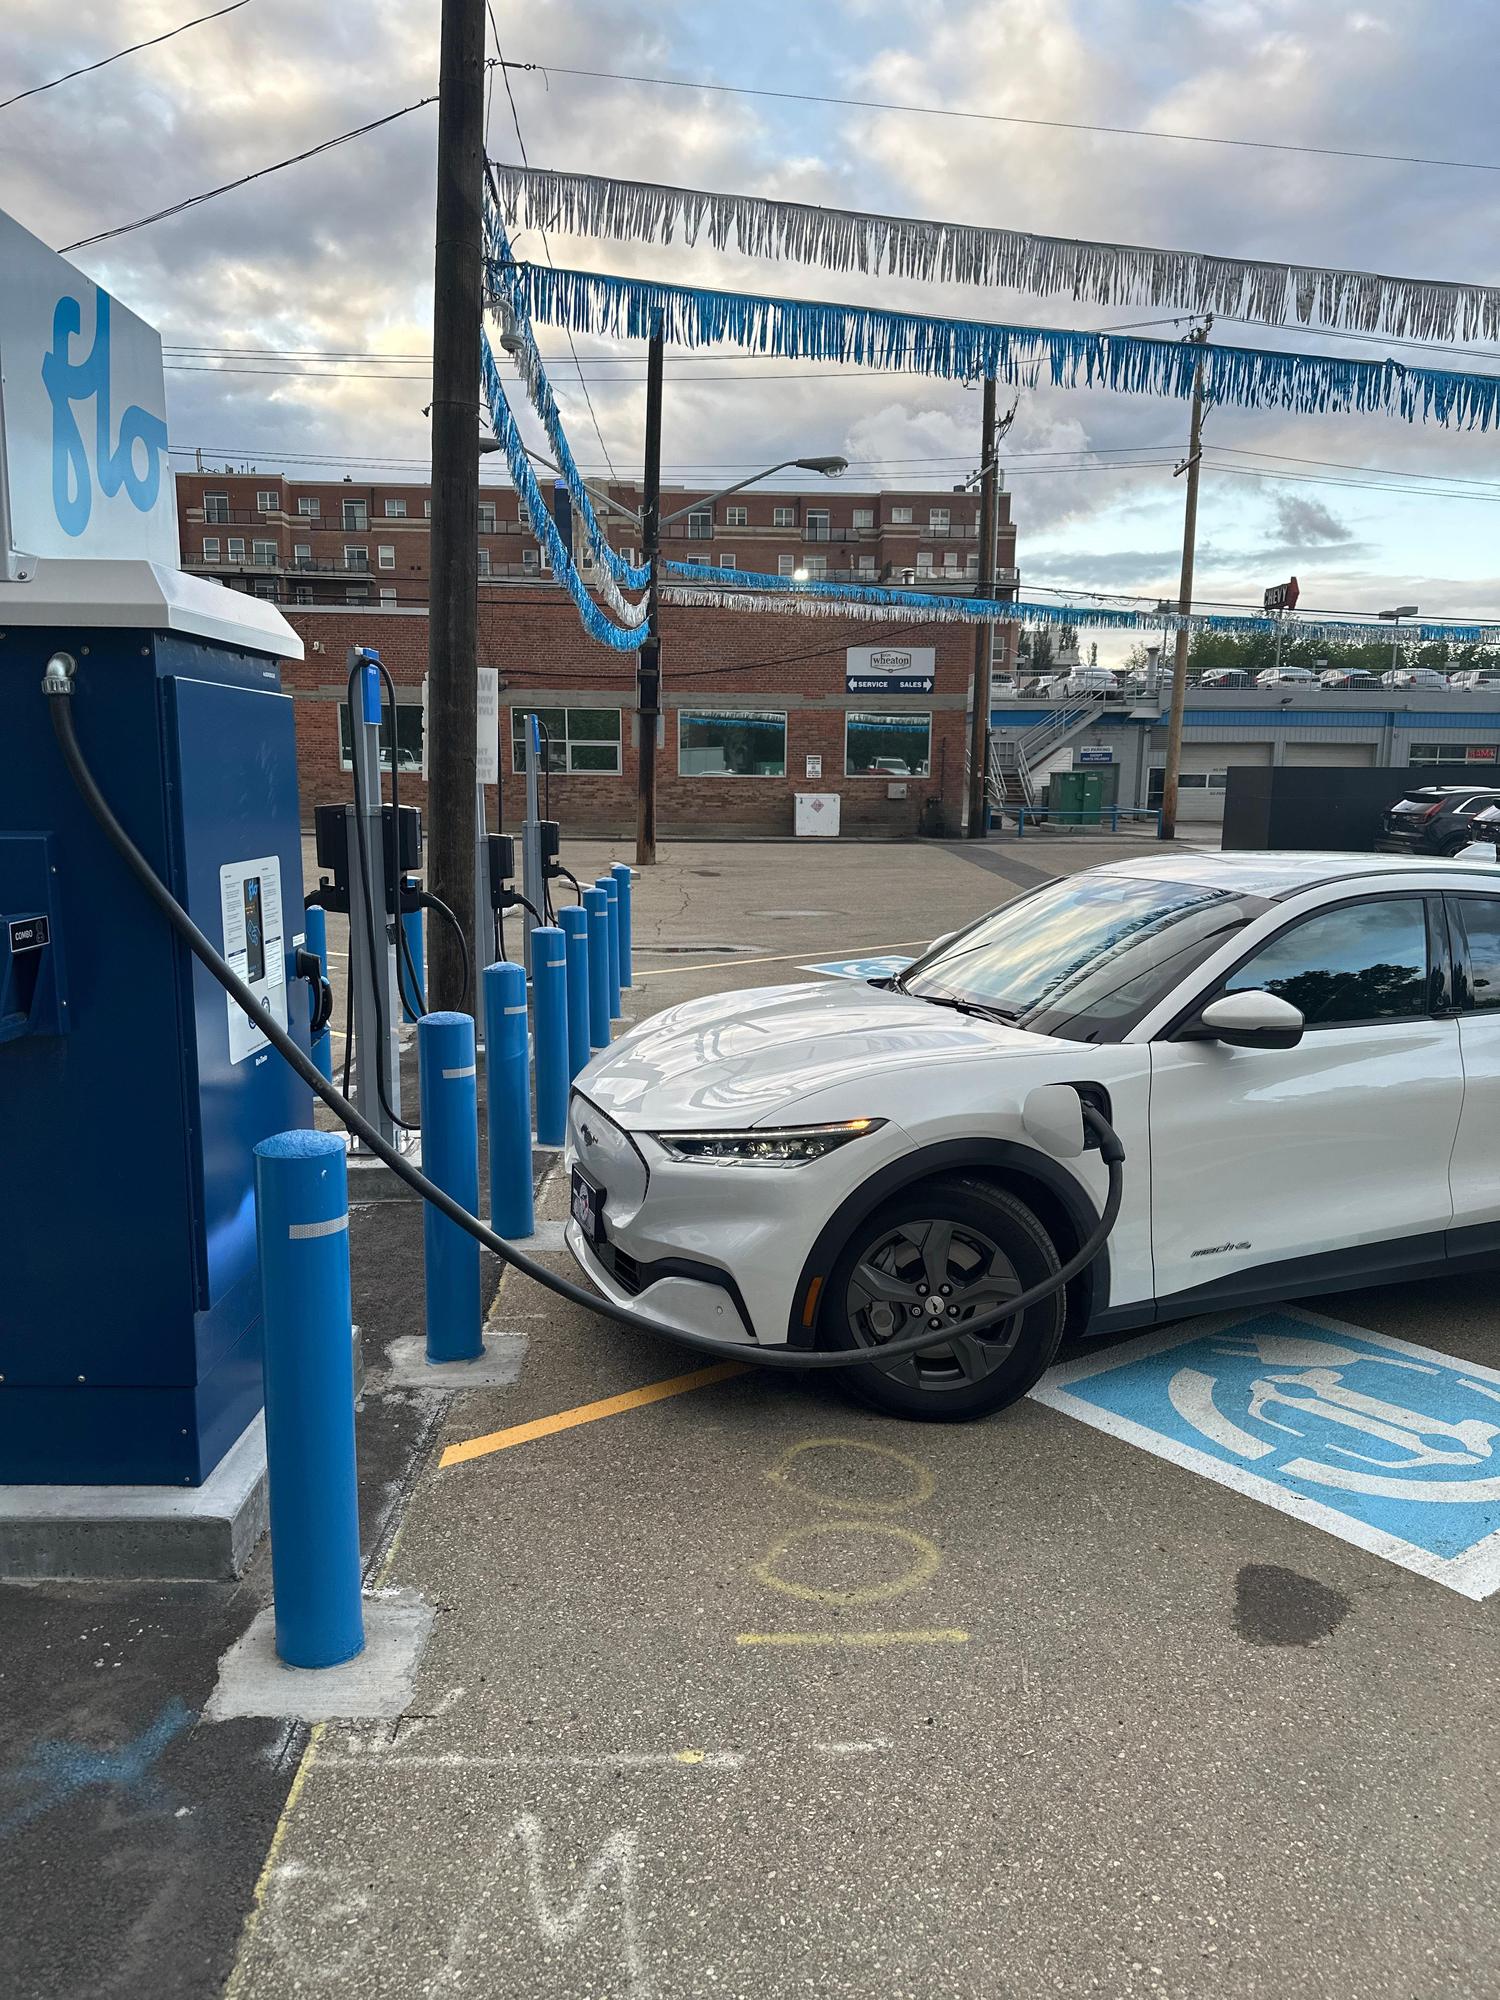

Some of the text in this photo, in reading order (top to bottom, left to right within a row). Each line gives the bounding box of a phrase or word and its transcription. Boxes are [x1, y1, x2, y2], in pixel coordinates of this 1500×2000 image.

[41, 285, 169, 538] flo
[1264, 585, 1288, 606] CHEVY
[873, 654, 909, 664] wheaton
[15, 929, 33, 941] COMBO
